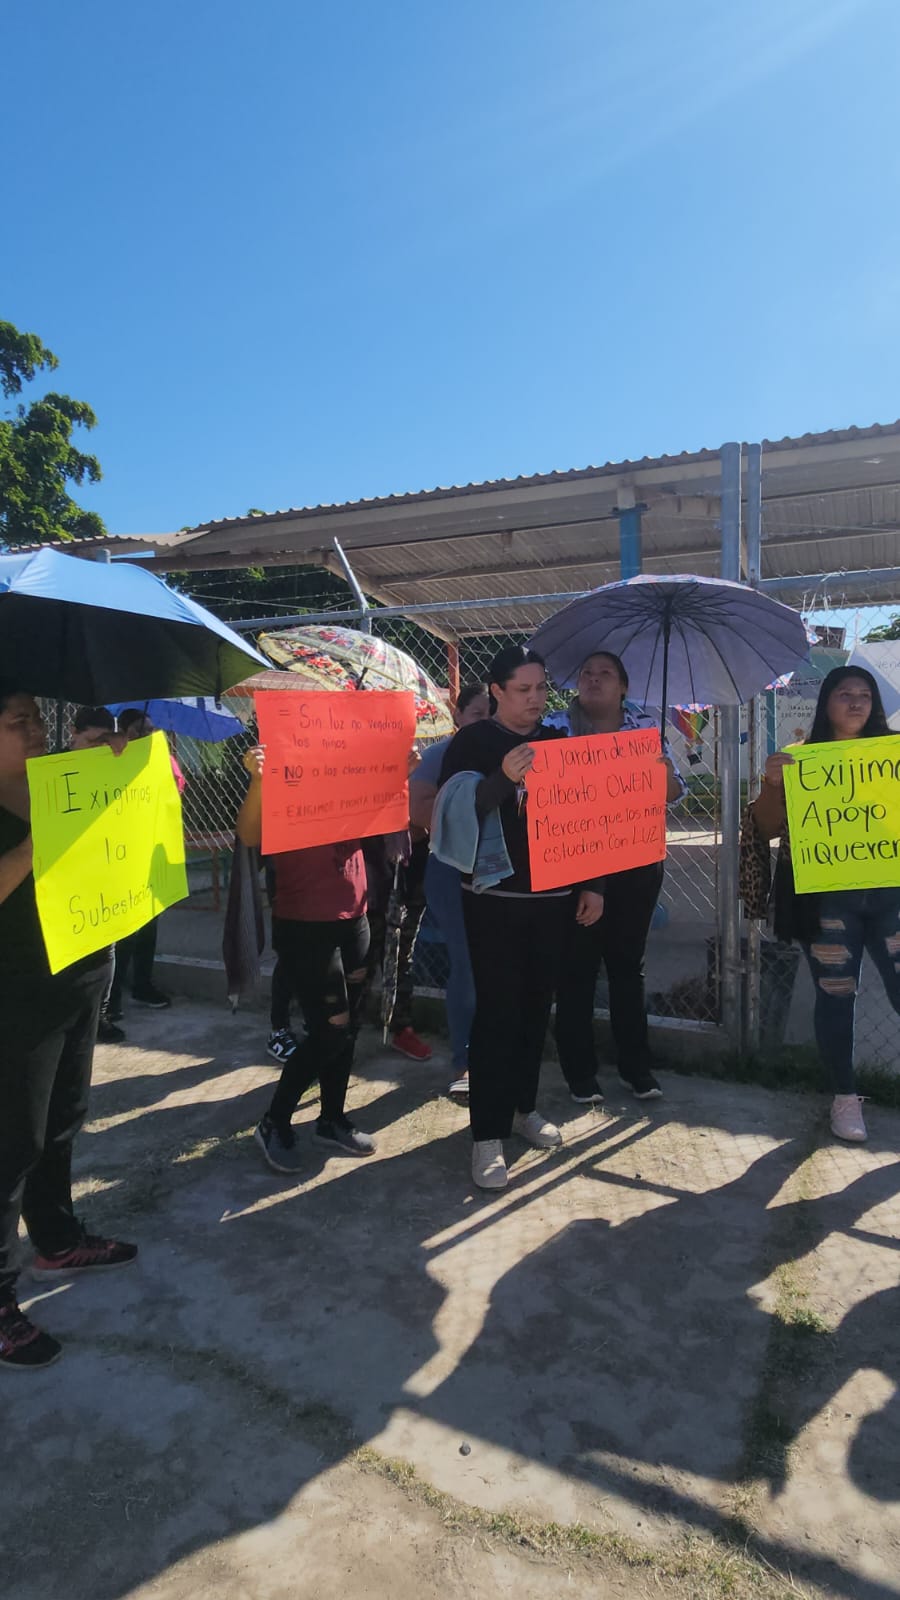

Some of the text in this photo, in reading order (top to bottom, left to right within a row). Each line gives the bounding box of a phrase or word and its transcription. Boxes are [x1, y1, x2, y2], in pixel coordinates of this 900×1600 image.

[299, 703, 322, 729] Sin
[328, 706, 345, 730] luz
[351, 720, 363, 732] no
[292, 733, 310, 748] los
[610, 736, 624, 759] de
[284, 765, 304, 780] NO
[324, 765, 337, 777] las
[536, 768, 654, 809] Gilberto OWEN
[536, 815, 597, 840] Merecen
[598, 811, 623, 835] que
[626, 809, 641, 823] los
[801, 801, 886, 837] Apoyo
[105, 837, 127, 864] la
[544, 836, 604, 864] estudien
